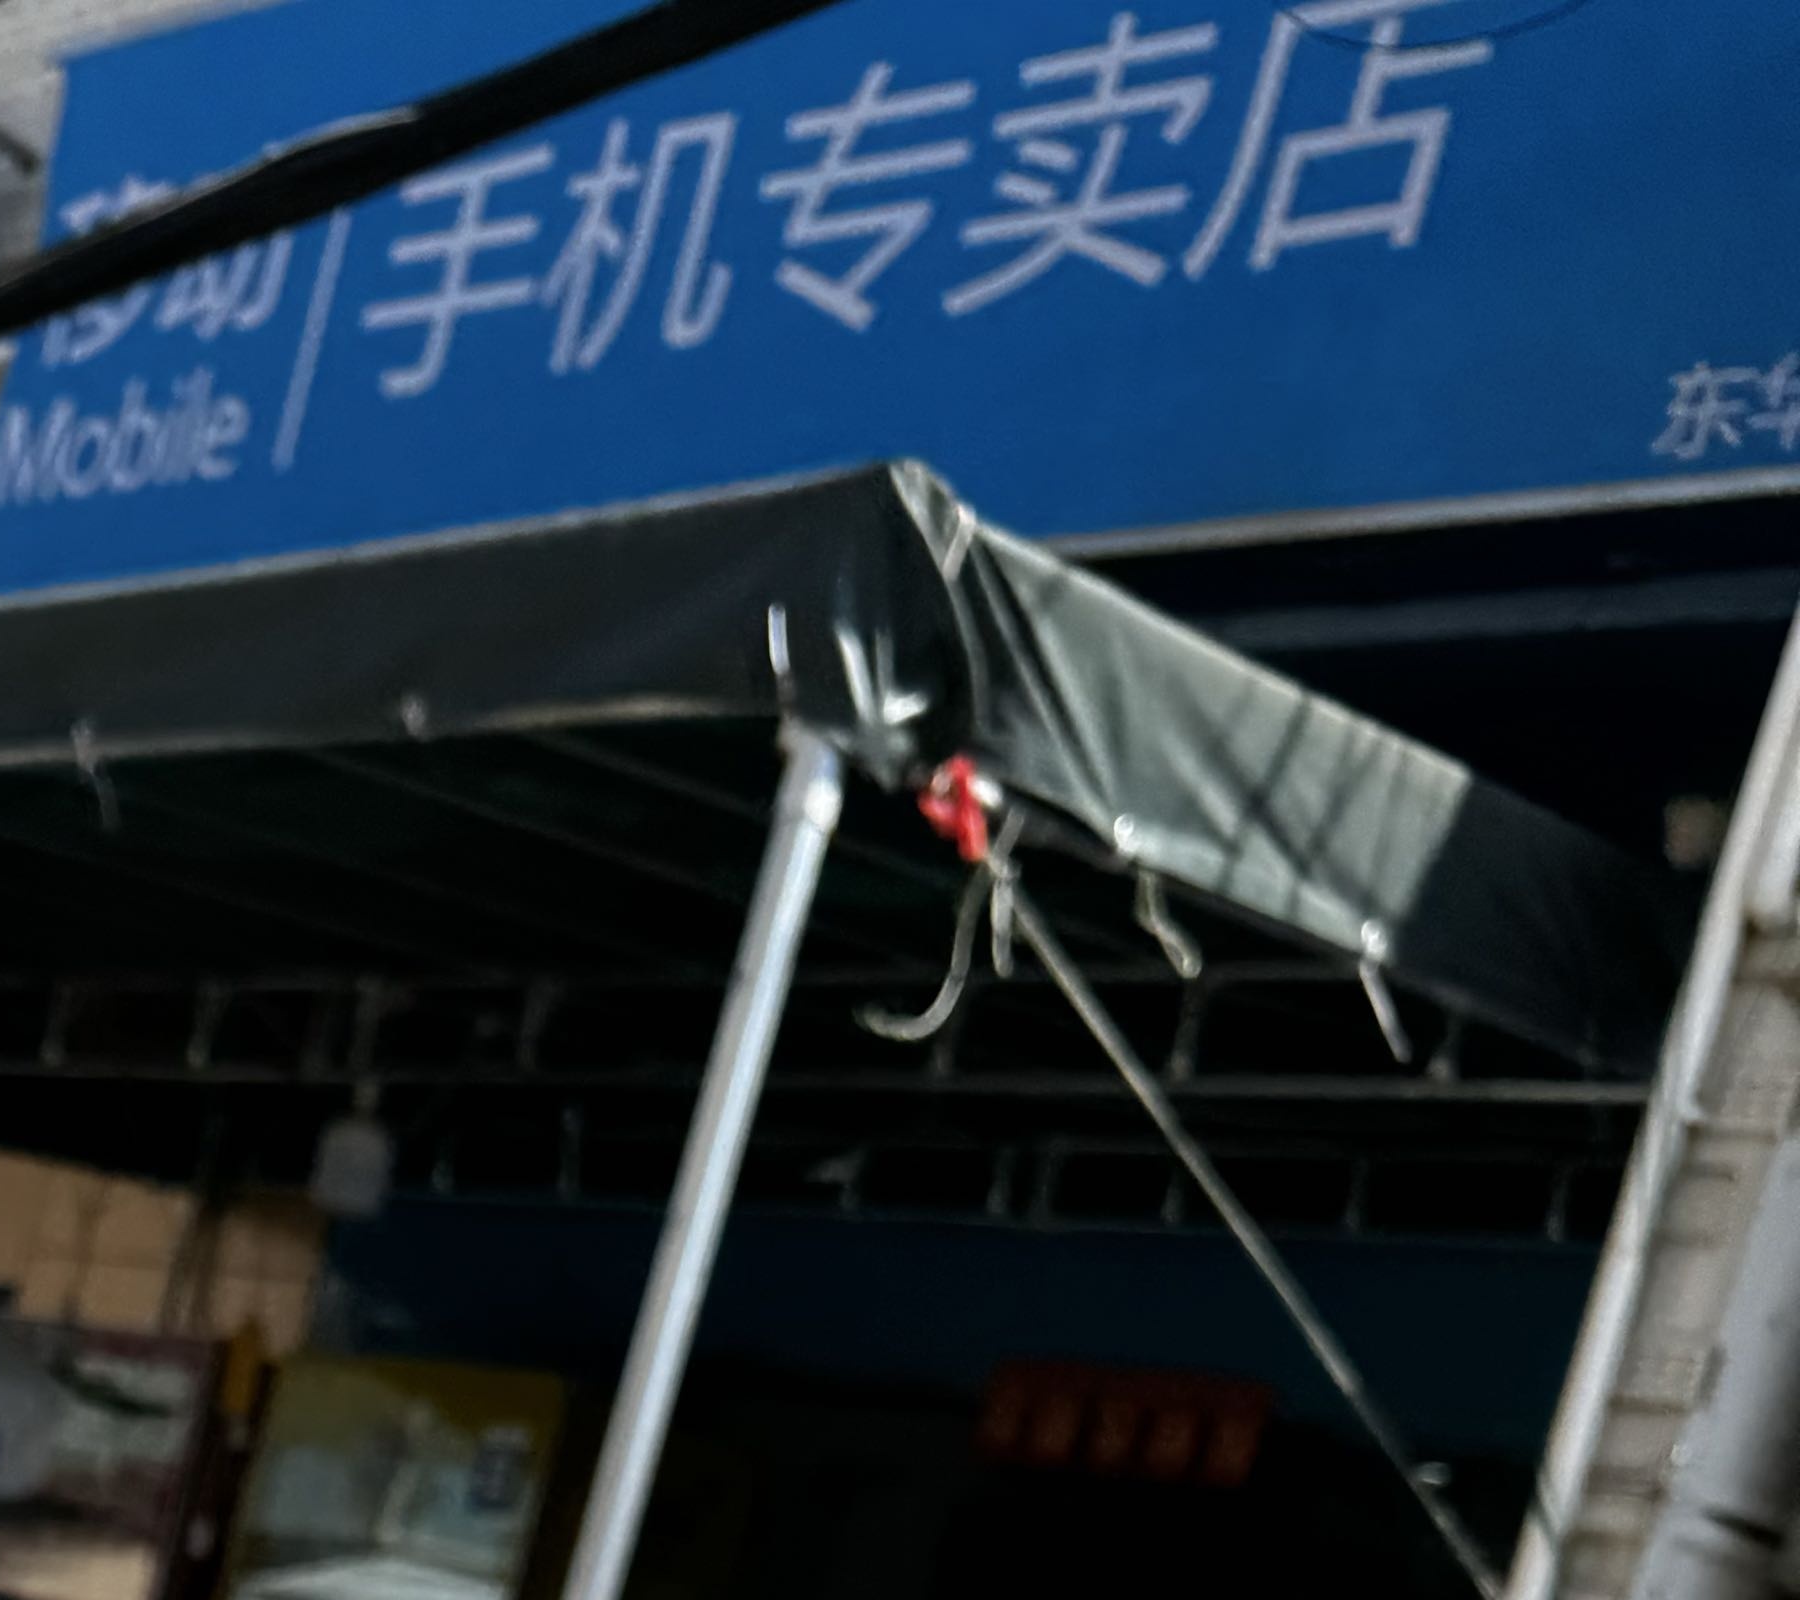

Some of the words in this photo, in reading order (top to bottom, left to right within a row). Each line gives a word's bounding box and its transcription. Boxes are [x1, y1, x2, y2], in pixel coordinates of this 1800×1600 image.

[360, 0, 1494, 399] 手机专卖店
